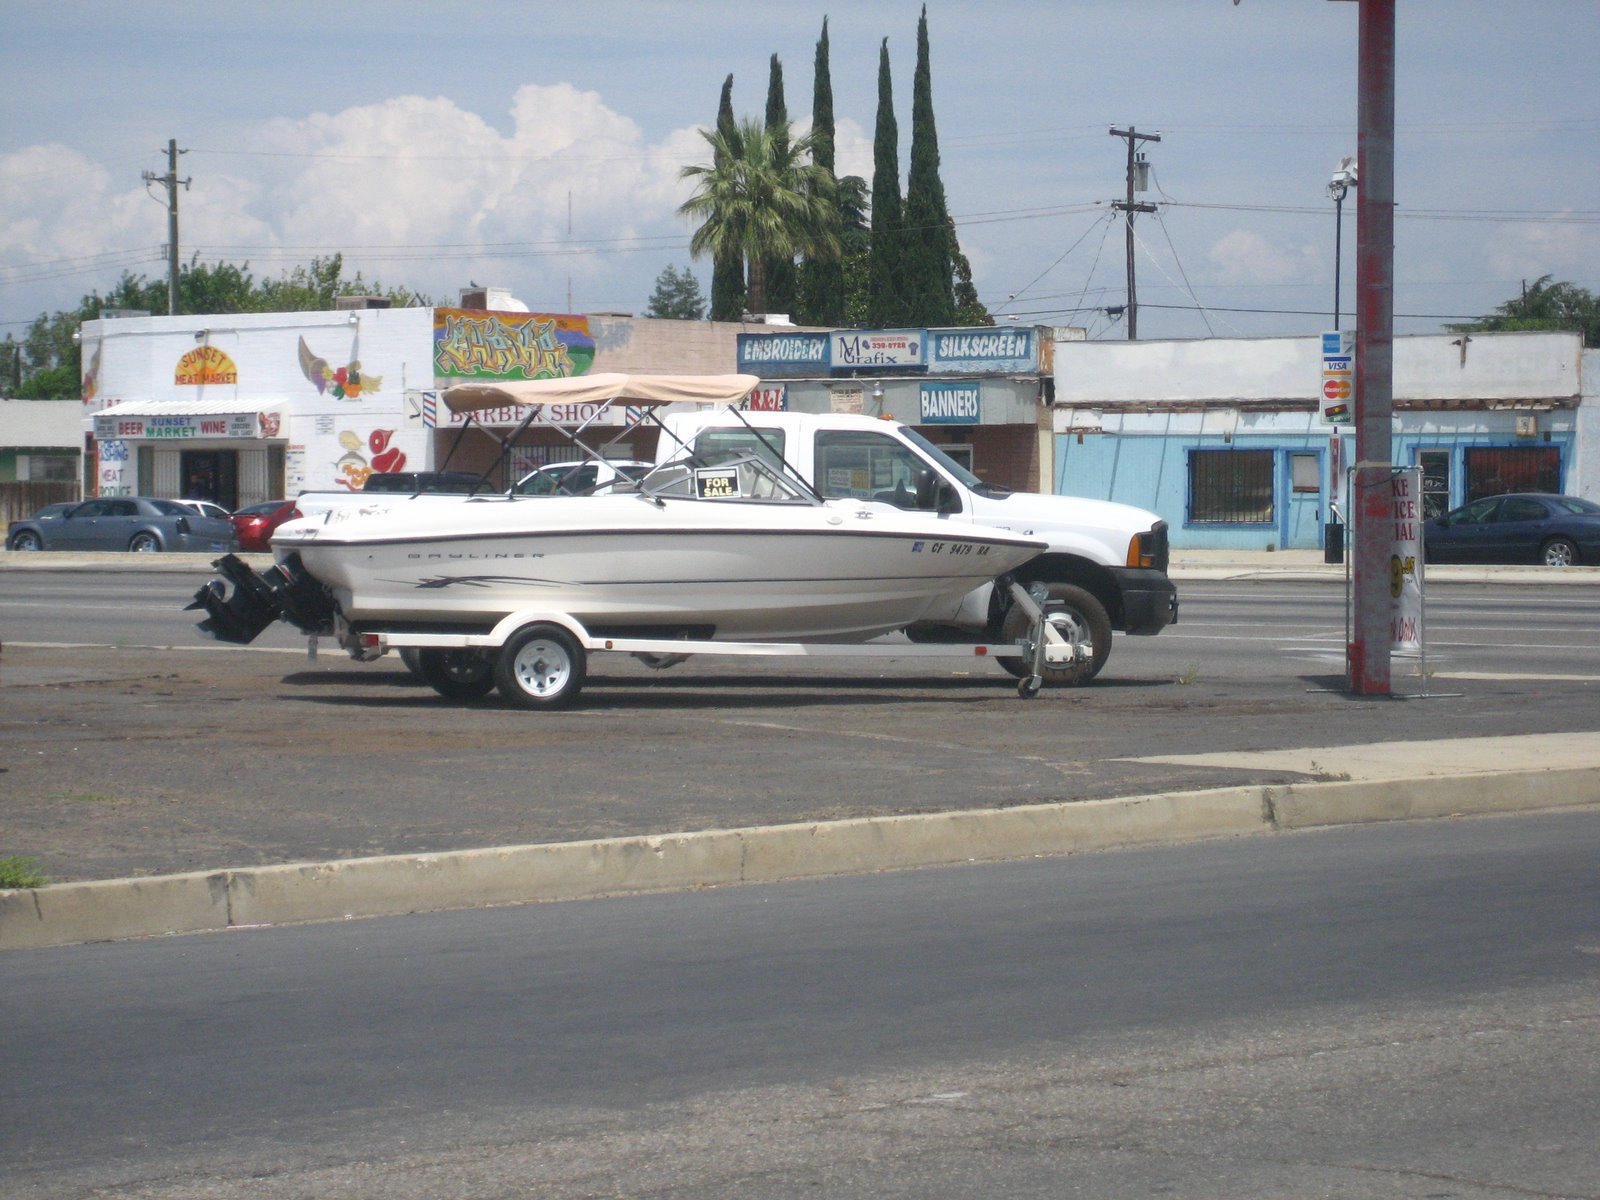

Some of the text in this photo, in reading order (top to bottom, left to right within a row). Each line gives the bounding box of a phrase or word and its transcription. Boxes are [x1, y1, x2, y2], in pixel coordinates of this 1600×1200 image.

[744, 339, 826, 360] EMBROIDERY
[940, 335, 1027, 357] SILKSCREEN
[181, 346, 227, 369] SUNSET
[1328, 362, 1348, 370] VISA
[175, 372, 238, 385] MEAT MARKET
[921, 389, 978, 417] BANNERS
[551, 405, 610, 422] SHOP
[150, 417, 193, 426] SUNSET
[201, 421, 226, 434] WINE
[118, 422, 143, 435] BEER
[146, 427, 196, 437] MARKET
[705, 478, 729, 487] FOR
[703, 487, 733, 497] SALE
[1391, 501, 1414, 519] ICE
[1392, 523, 1415, 541] IAL
[932, 542, 944, 553] CF
